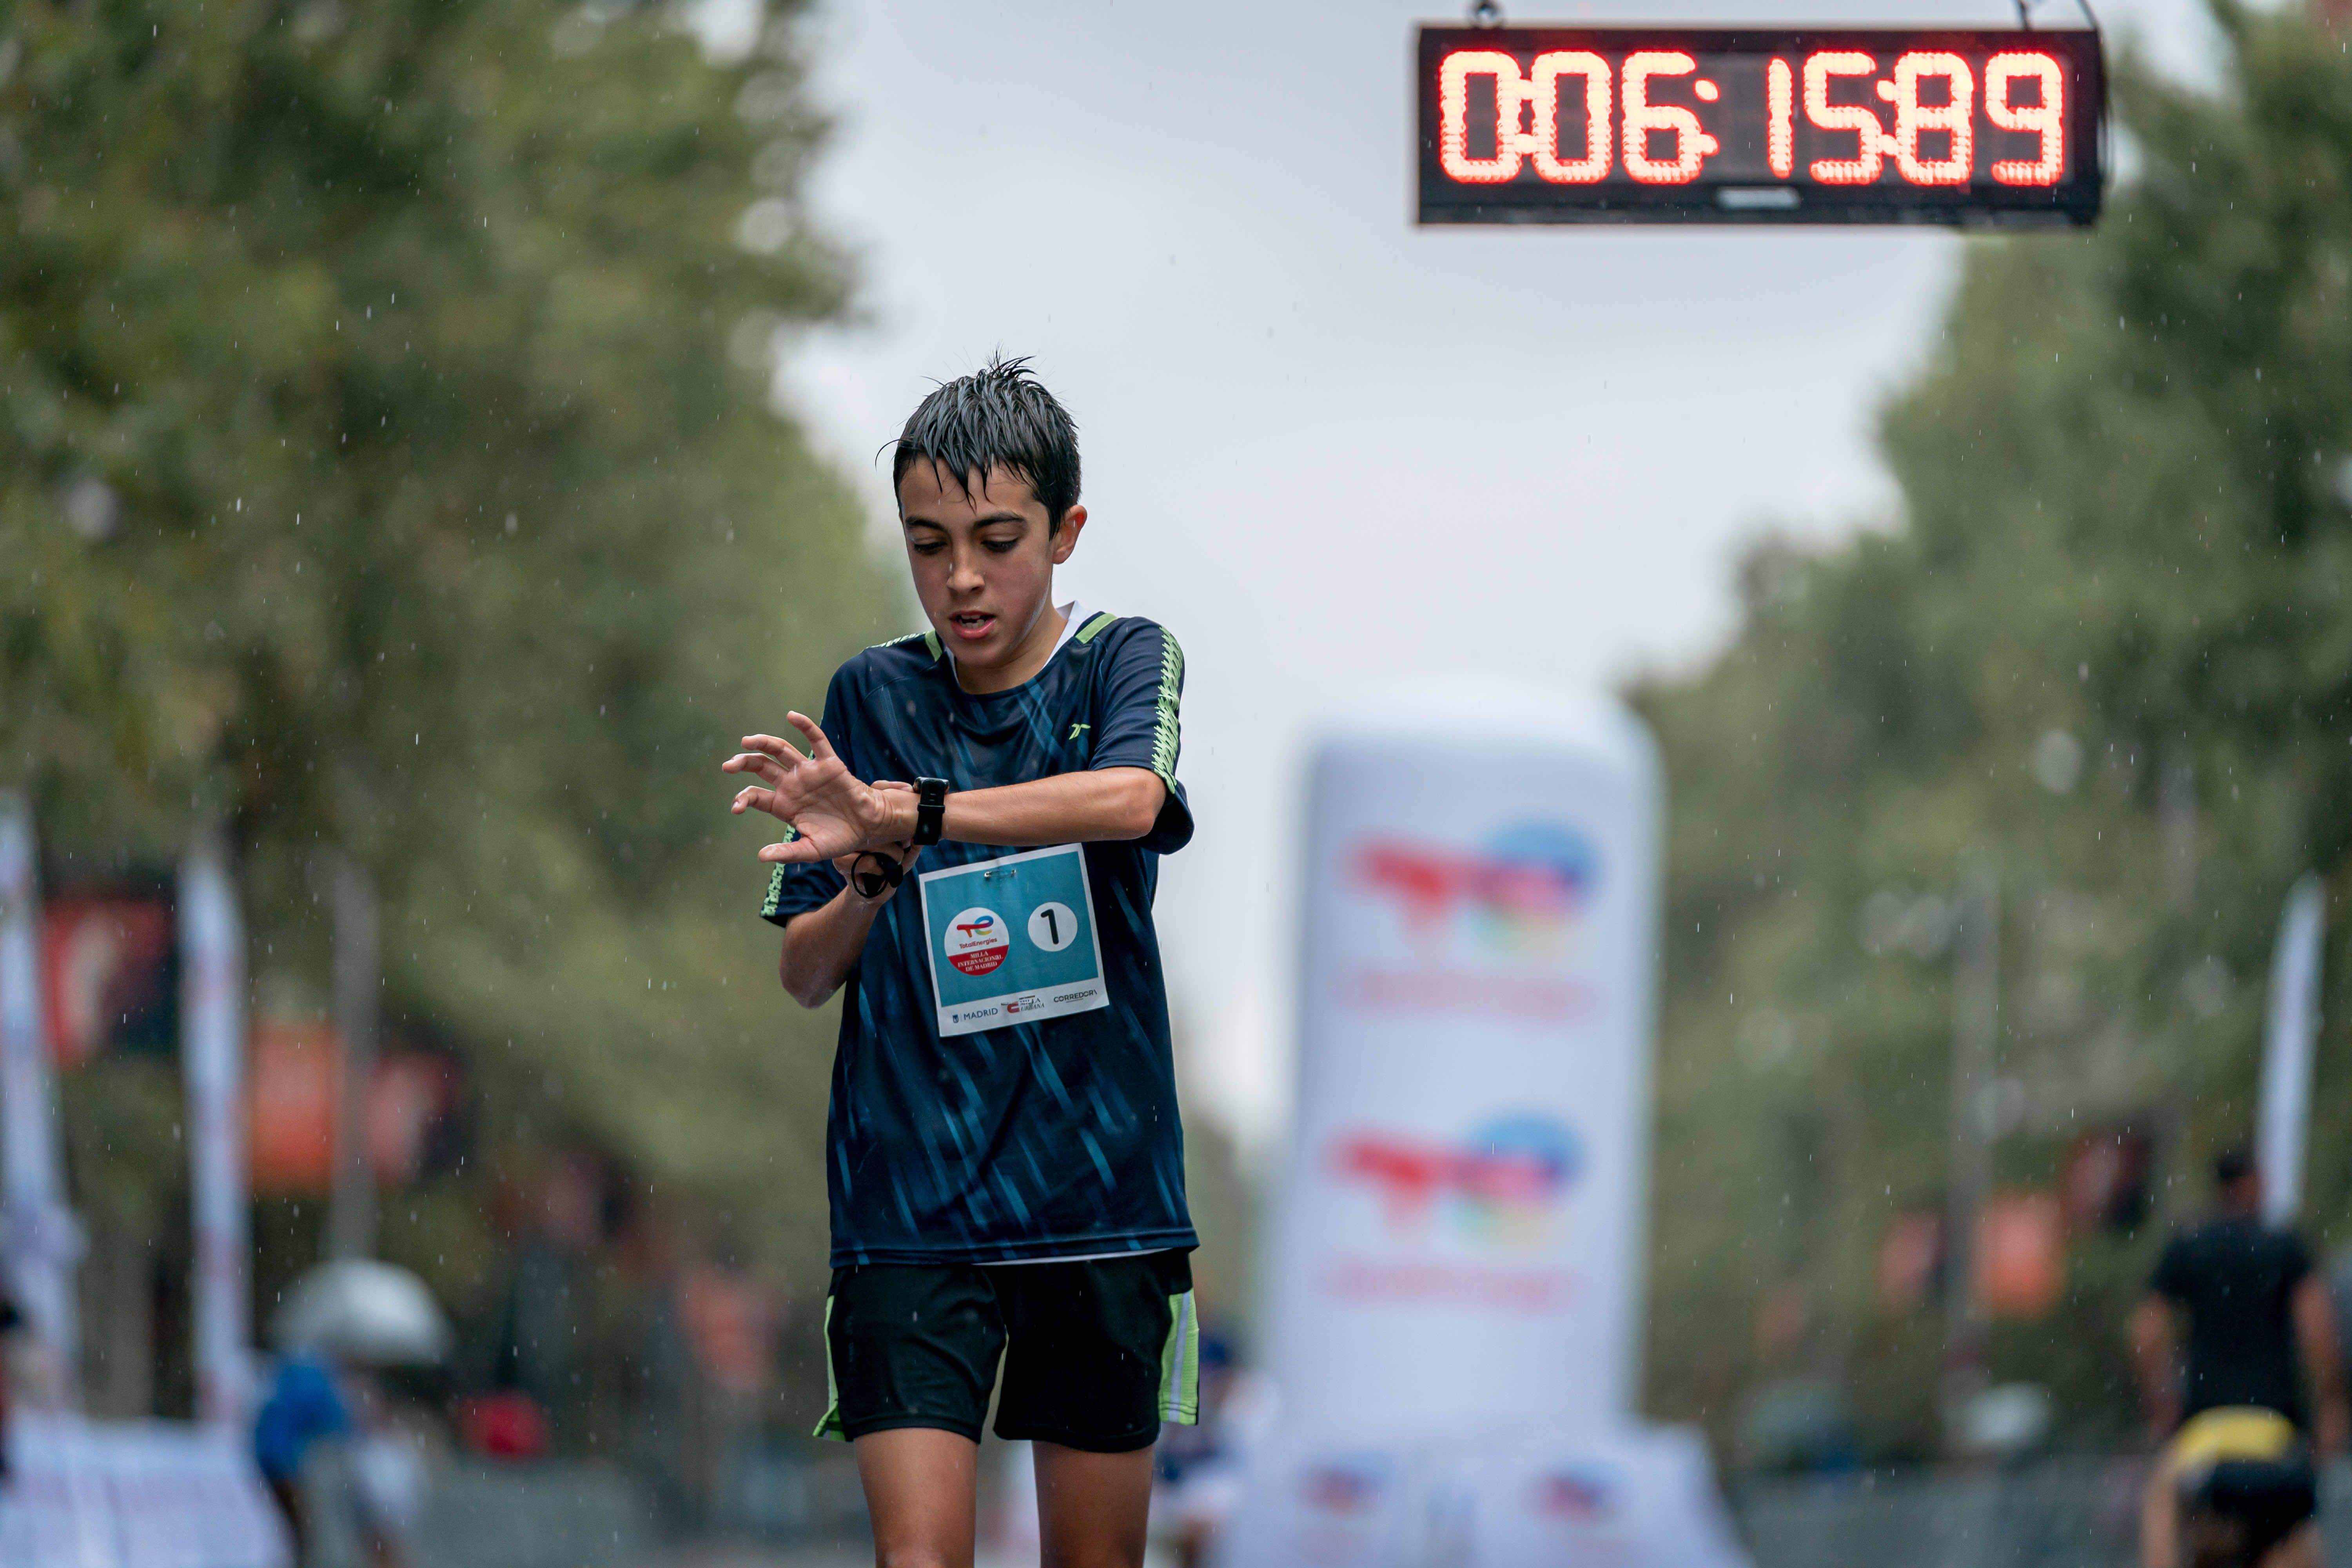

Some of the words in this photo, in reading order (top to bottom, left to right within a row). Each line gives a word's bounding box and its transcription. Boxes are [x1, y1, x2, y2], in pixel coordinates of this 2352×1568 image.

[1040, 908, 1059, 945] 1
[959, 938, 998, 949] TotalEnergies
[957, 954, 1004, 967] INTERNACIONAL
[975, 961, 997, 970] MADRID
[964, 1008, 998, 1020] MADRID
